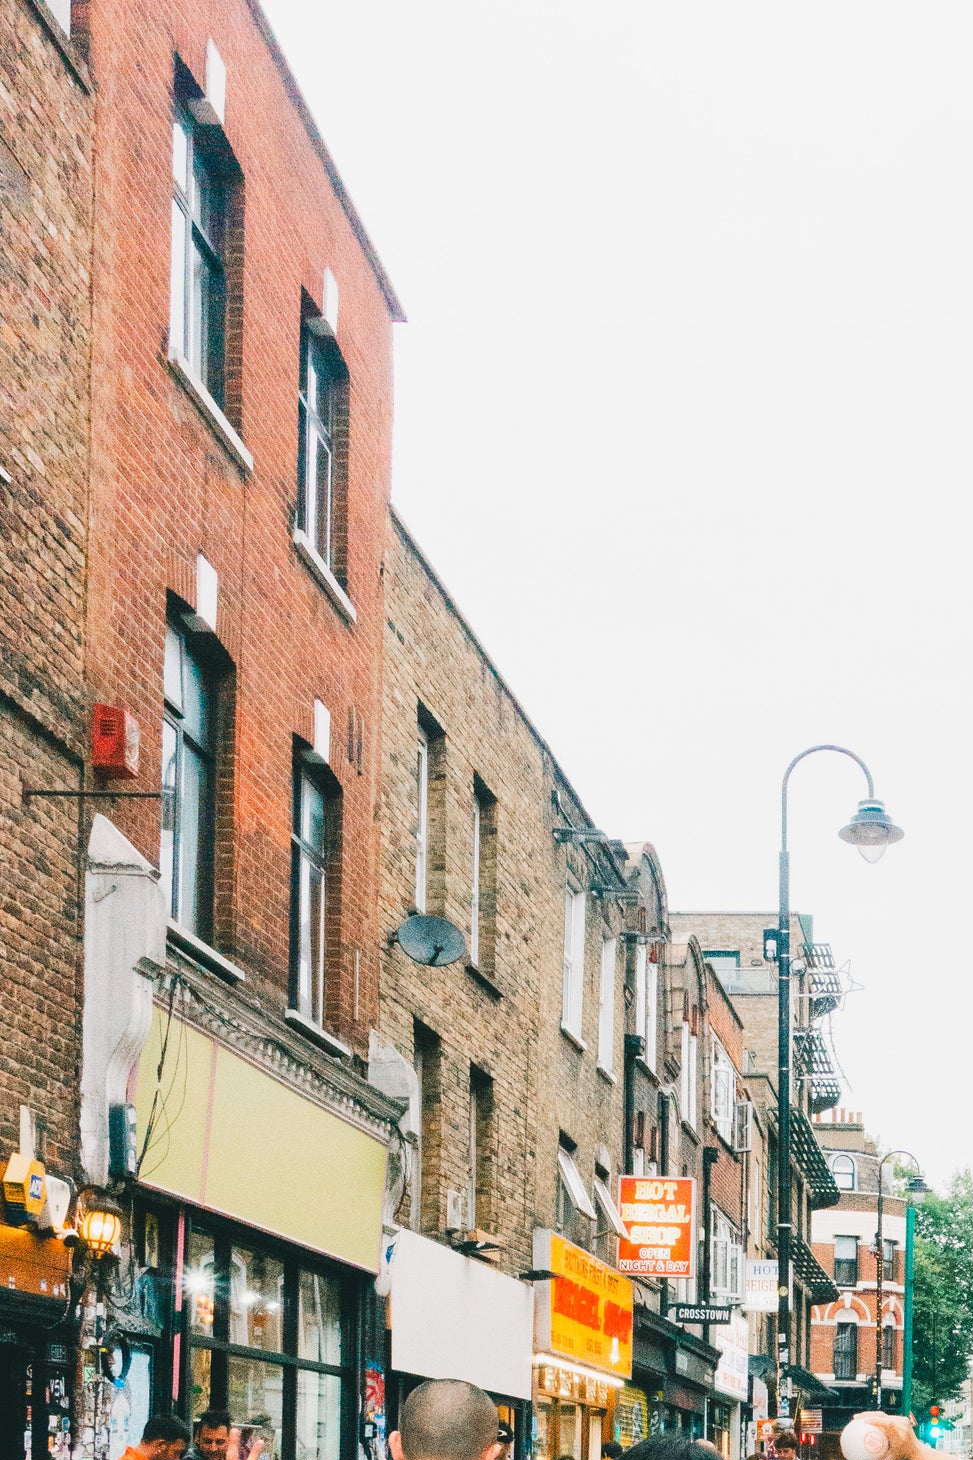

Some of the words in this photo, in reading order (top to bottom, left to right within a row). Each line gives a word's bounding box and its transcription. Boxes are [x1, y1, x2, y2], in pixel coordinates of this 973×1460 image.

[635, 1181, 677, 1200] HOT
[630, 1225, 682, 1245] SHOP
[639, 1247, 671, 1259] OPEN
[620, 1259, 655, 1271] NIGHT
[656, 1261, 665, 1271] &
[666, 1261, 688, 1272] DAY
[753, 1265, 779, 1275] HOT
[678, 1308, 729, 1321] CROSSTOWN
